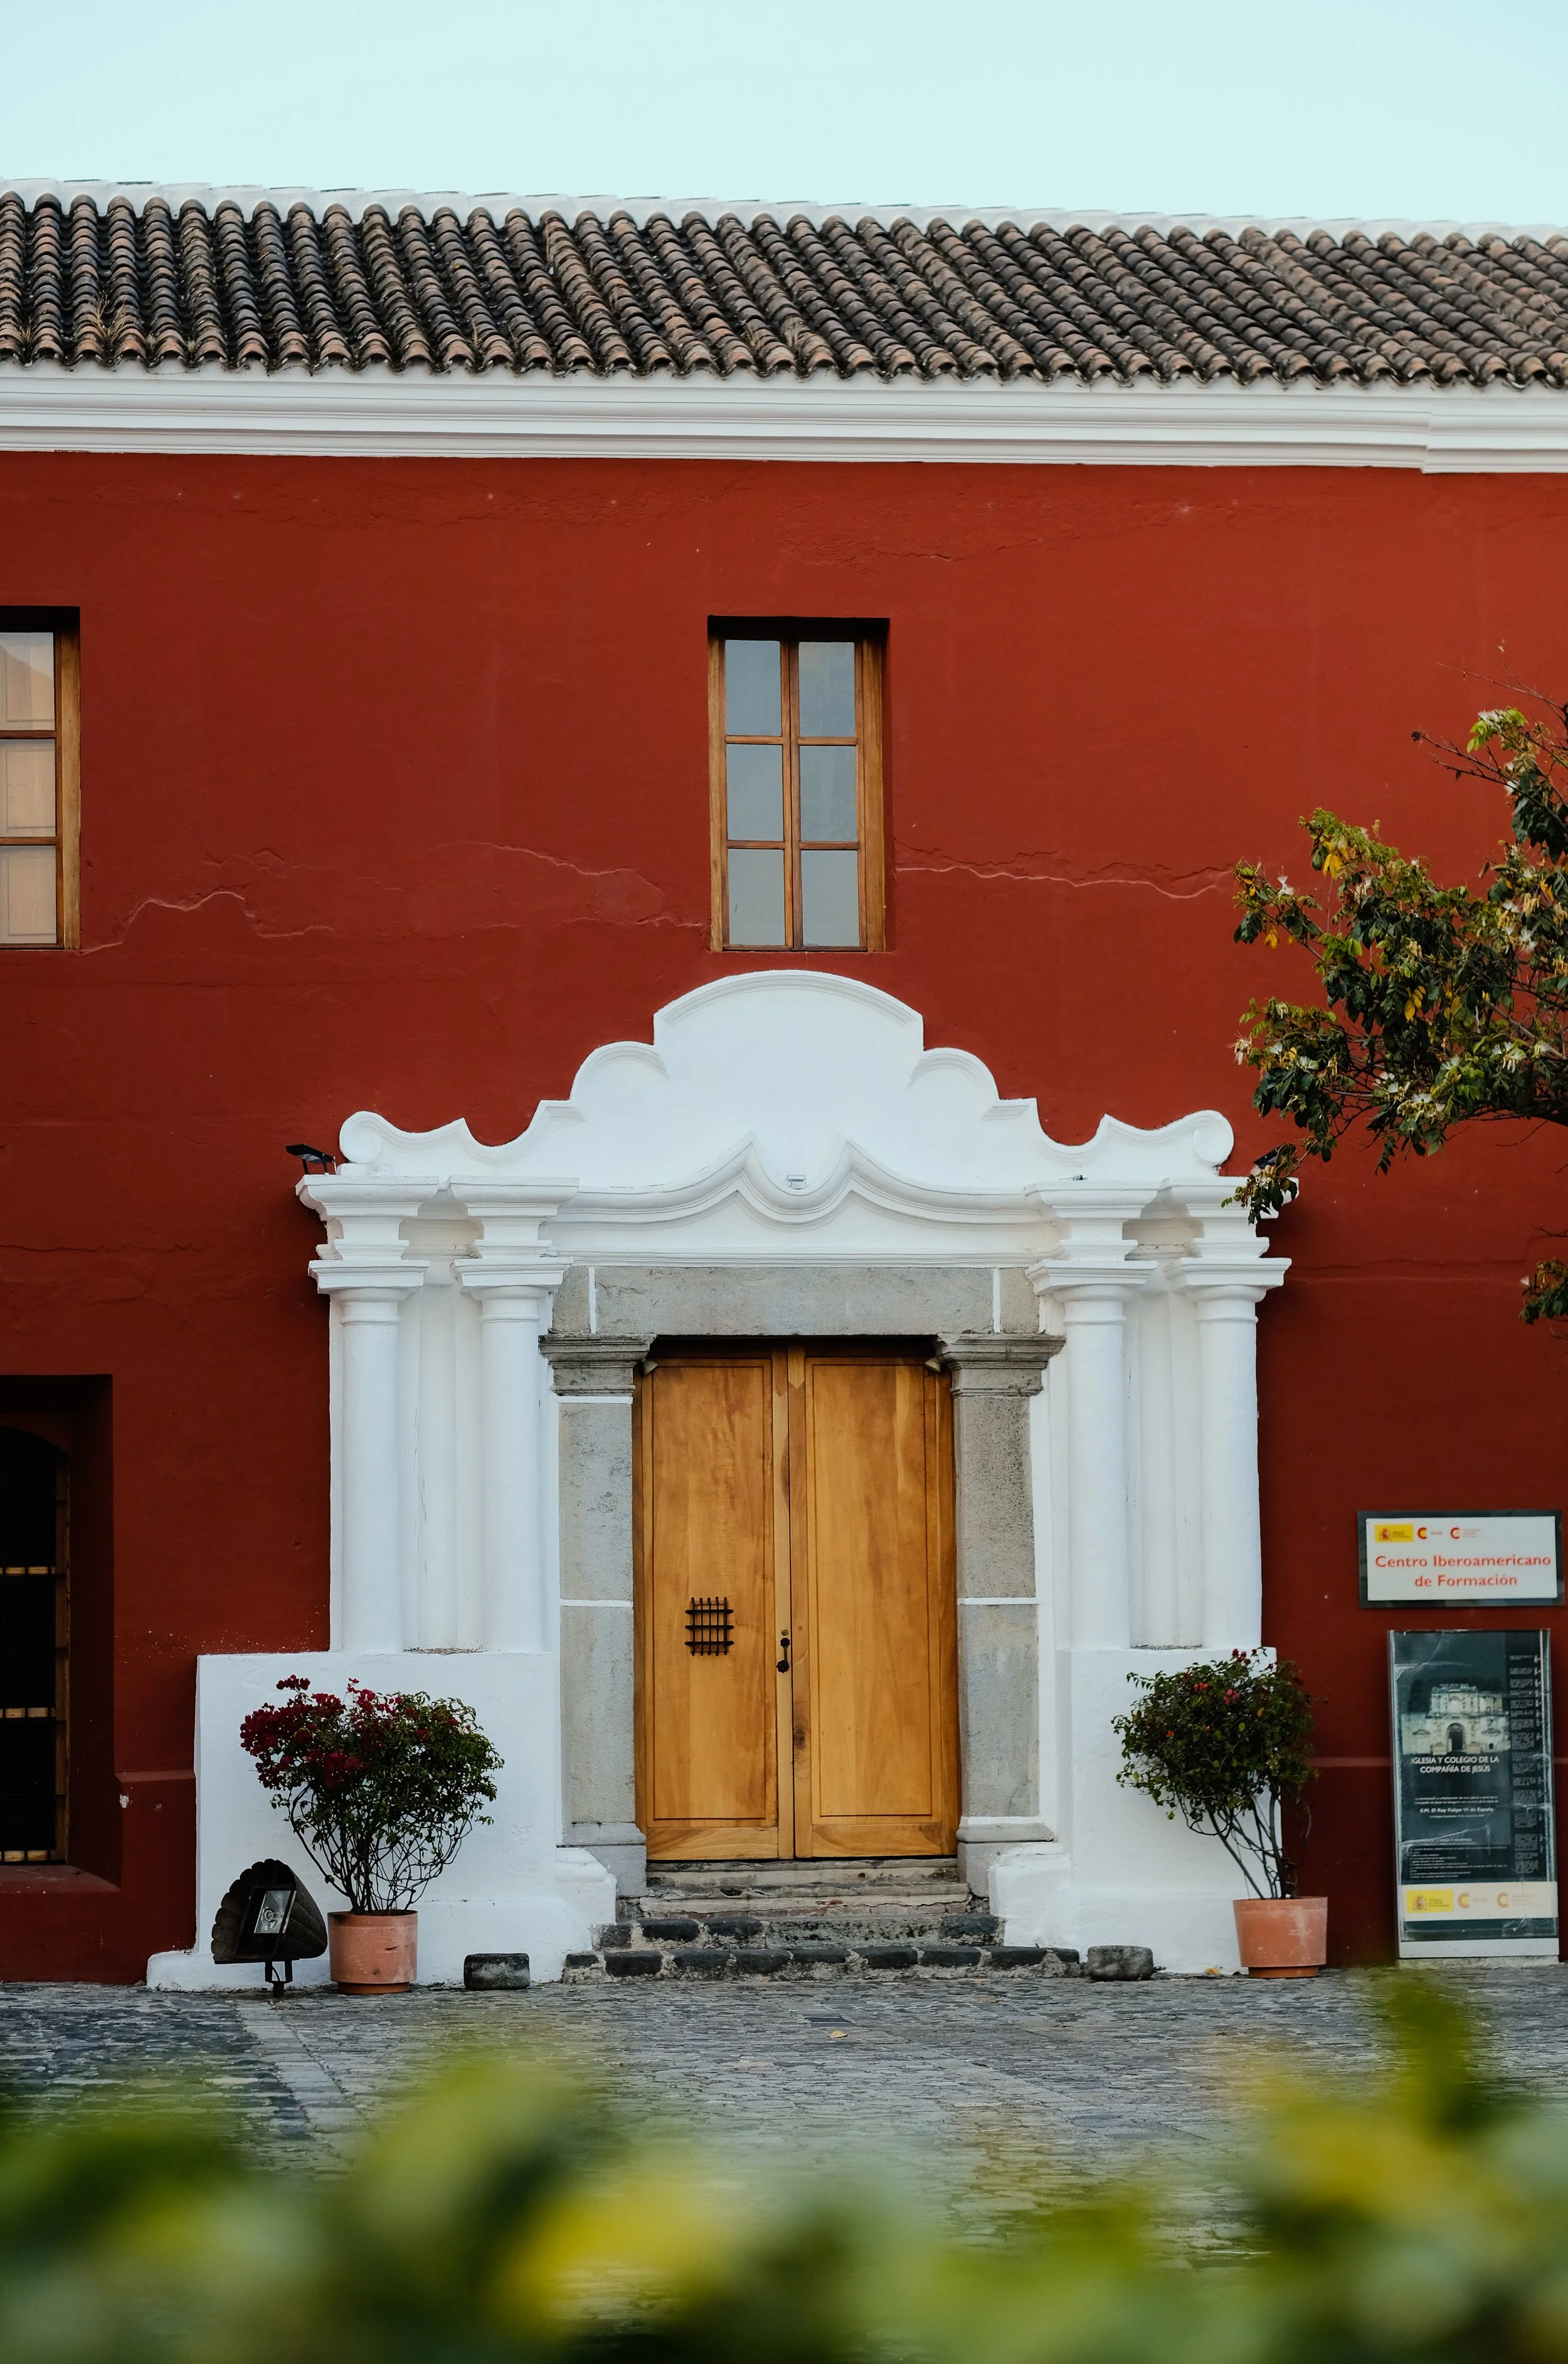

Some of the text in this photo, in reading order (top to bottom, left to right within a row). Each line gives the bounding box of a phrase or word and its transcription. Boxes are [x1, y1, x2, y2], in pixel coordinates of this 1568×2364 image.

[1375, 1554, 1551, 1567] Centro Iberoamericano
[1414, 1573, 1517, 1587] de Formación
[1478, 1756, 1489, 1764] DE
[1419, 1764, 1491, 1774] COMPAÑÍA DE JESÚS
